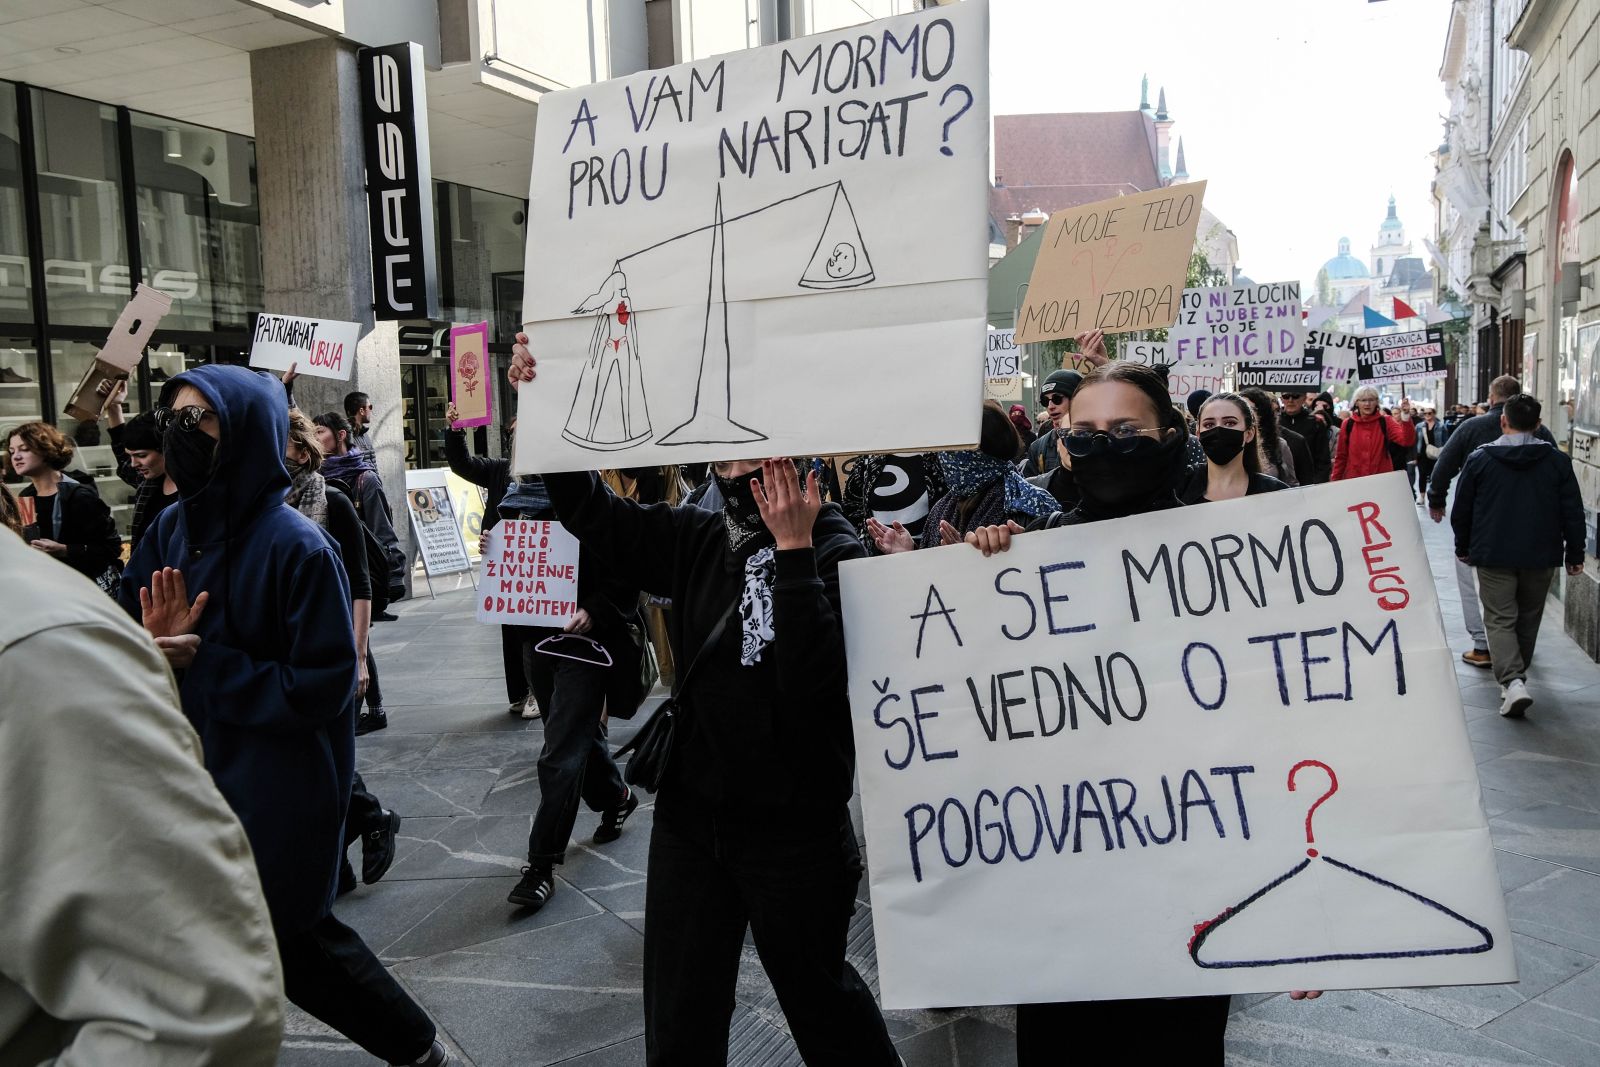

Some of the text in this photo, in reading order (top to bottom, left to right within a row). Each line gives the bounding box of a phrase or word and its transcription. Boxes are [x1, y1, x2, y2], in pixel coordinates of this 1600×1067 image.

[563, 19, 955, 154] A VAM MORMO
[372, 54, 413, 312] MASS
[568, 142, 669, 220] PROU
[1054, 194, 1194, 249] MOJE TELO
[1181, 283, 1300, 309] TO NI ZLOČIN
[1021, 284, 1173, 338] MOJA IZBIRA
[1179, 305, 1296, 325] IZ LJUBEZNI
[255, 316, 319, 351] PATRIARHAT
[1210, 321, 1257, 334] TO JE
[1177, 329, 1296, 361] FEMICID
[1360, 338, 1368, 352] 1
[1372, 334, 1422, 348] ZASTAVICA
[992, 356, 1019, 376] YES!
[1358, 351, 1380, 366] 110
[1385, 348, 1409, 360] SMRTI
[1375, 364, 1400, 375] VSAK
[504, 521, 551, 535] MOJE
[504, 535, 552, 553] TELO,
[1348, 501, 1410, 611] RES
[502, 551, 547, 564] MOJE
[486, 560, 576, 584] ŽIVLJENJE,
[500, 580, 547, 594] MOJA
[911, 518, 1344, 659] A SE MORMO
[484, 595, 576, 618] ODLOČITEV!
[872, 619, 1407, 771] ŠE VEDNO O TEM
[904, 765, 1255, 883] POGOVARJAT
